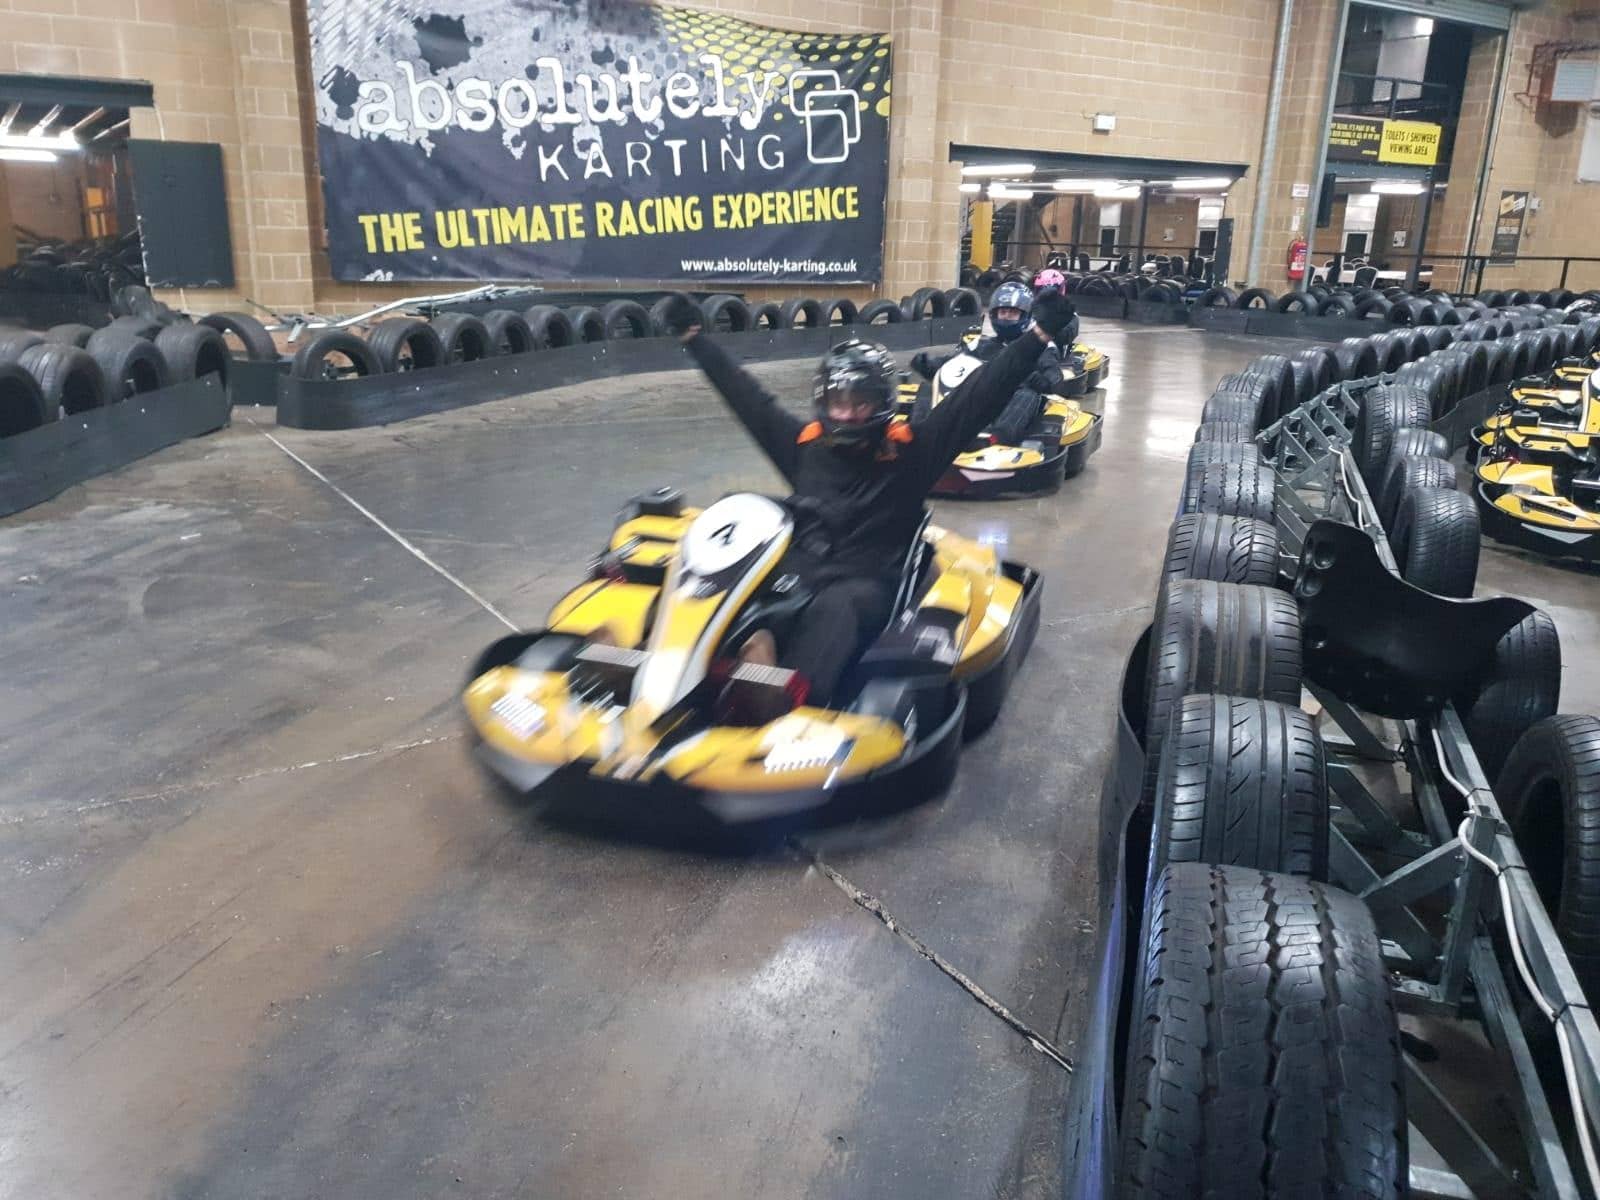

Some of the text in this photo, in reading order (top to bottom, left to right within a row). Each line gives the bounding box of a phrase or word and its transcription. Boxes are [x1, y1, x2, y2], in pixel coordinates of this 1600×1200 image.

[356, 53, 779, 132] absolutely
[1385, 129, 1405, 142] TOILETS
[1411, 132, 1437, 144] SHOWERS
[1390, 144, 1428, 155] VIEWING AREA
[537, 134, 785, 182] KARTING
[358, 186, 860, 253] THE ULTIMATE RACING EXPERIENCE
[681, 256, 858, 275] www.absolutely-karting.co.uk
